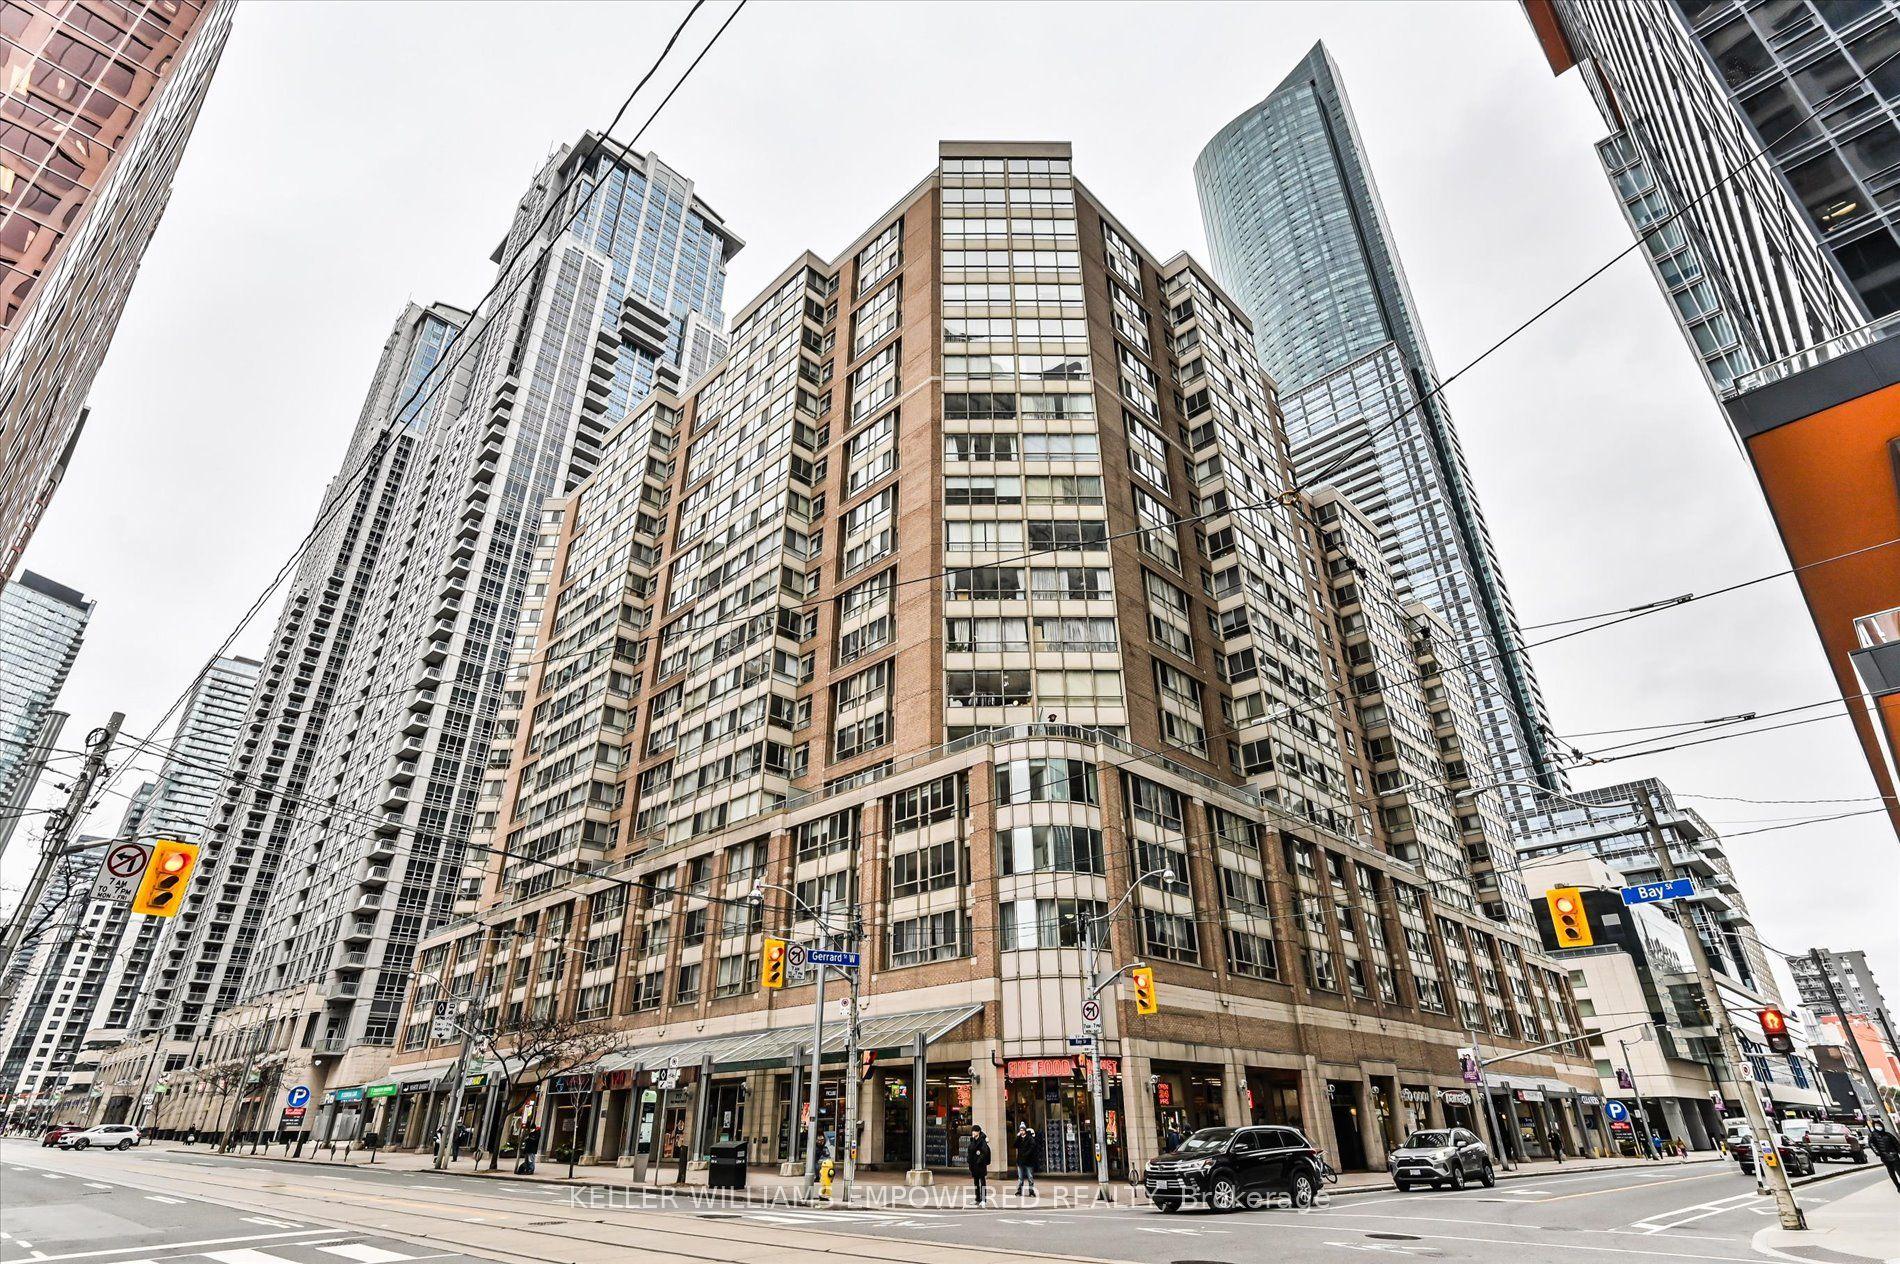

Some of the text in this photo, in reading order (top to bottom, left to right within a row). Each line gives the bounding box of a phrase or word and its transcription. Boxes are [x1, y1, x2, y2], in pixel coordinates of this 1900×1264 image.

[1637, 886, 1663, 900] Bay
[812, 951, 842, 962] Gerrard
[849, 954, 856, 963] W
[1037, 1059, 1071, 1076] FOOD
[292, 1088, 307, 1104] P
[1609, 1103, 1622, 1119] P
